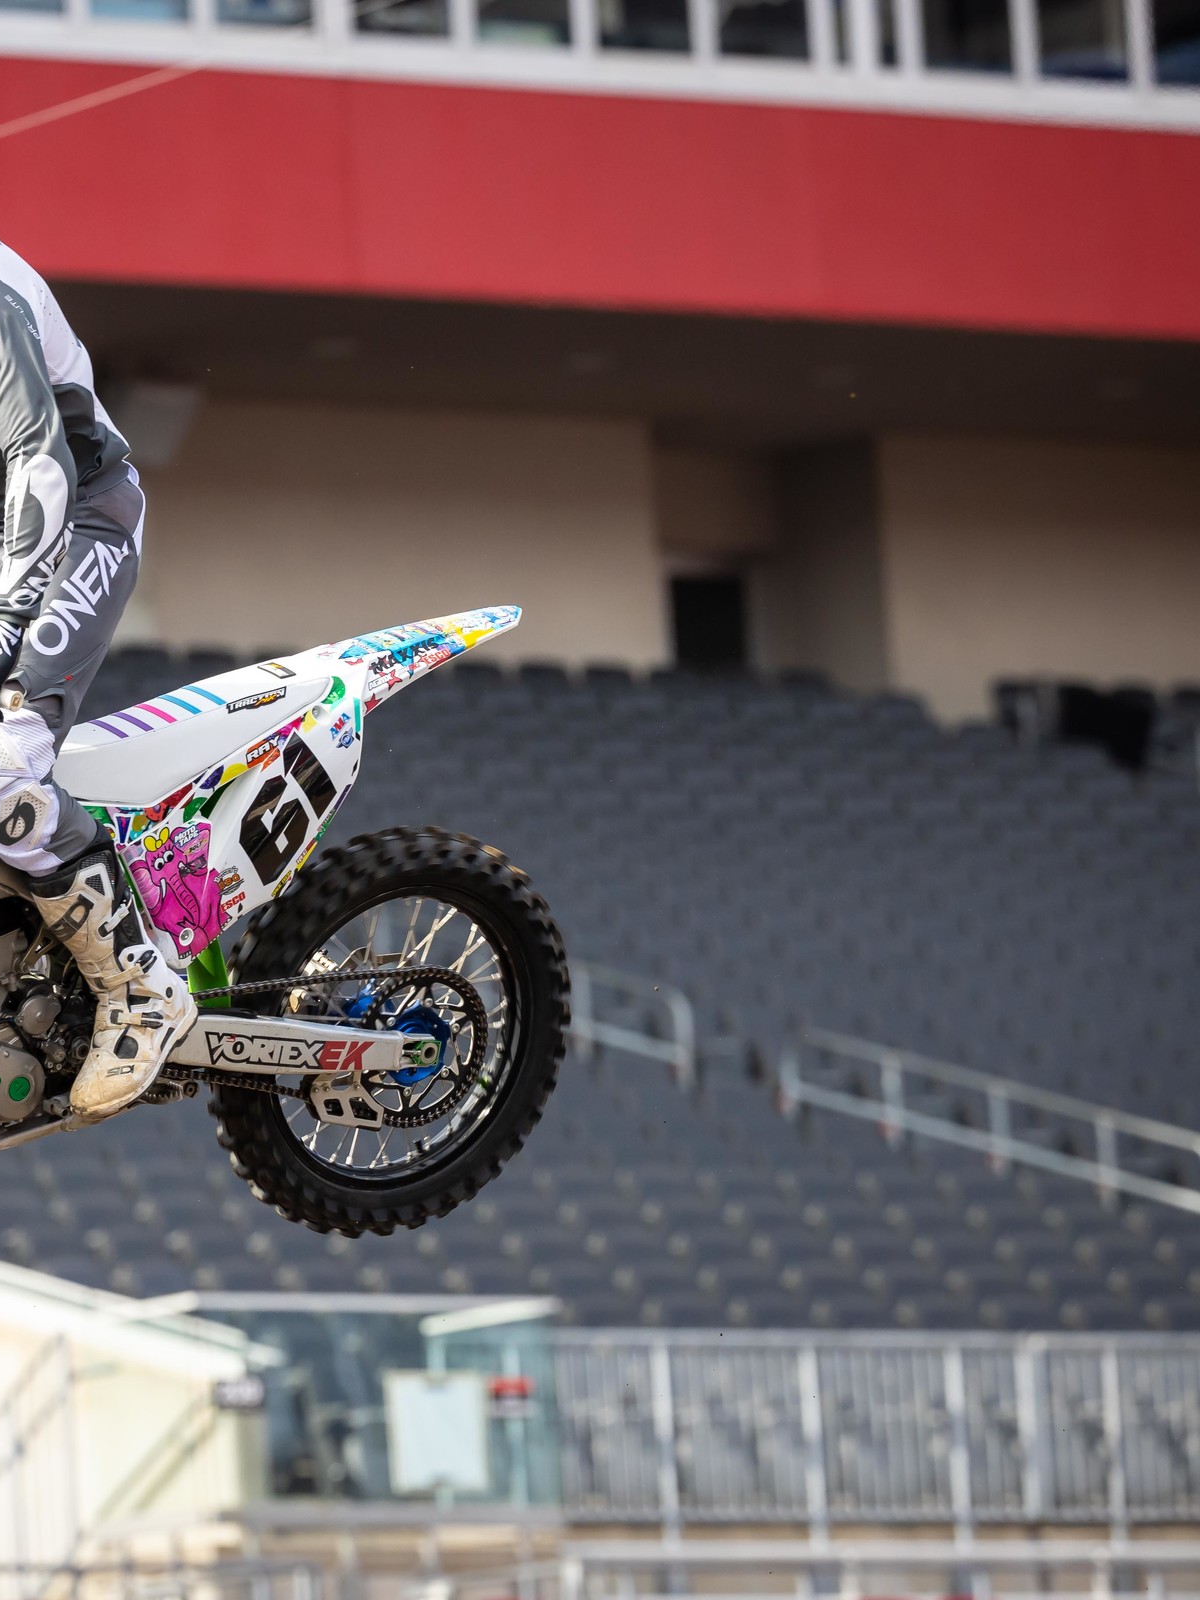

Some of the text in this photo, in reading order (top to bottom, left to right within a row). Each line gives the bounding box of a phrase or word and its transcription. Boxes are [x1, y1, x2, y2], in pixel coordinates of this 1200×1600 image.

[371, 638, 439, 674] MAXXIS
[330, 712, 350, 740] AMA
[247, 734, 280, 763] RAY
[239, 730, 337, 886] 61
[174, 825, 196, 842] MOTO
[179, 829, 199, 846] TAPE
[205, 1031, 375, 1070] VORTEX EK
